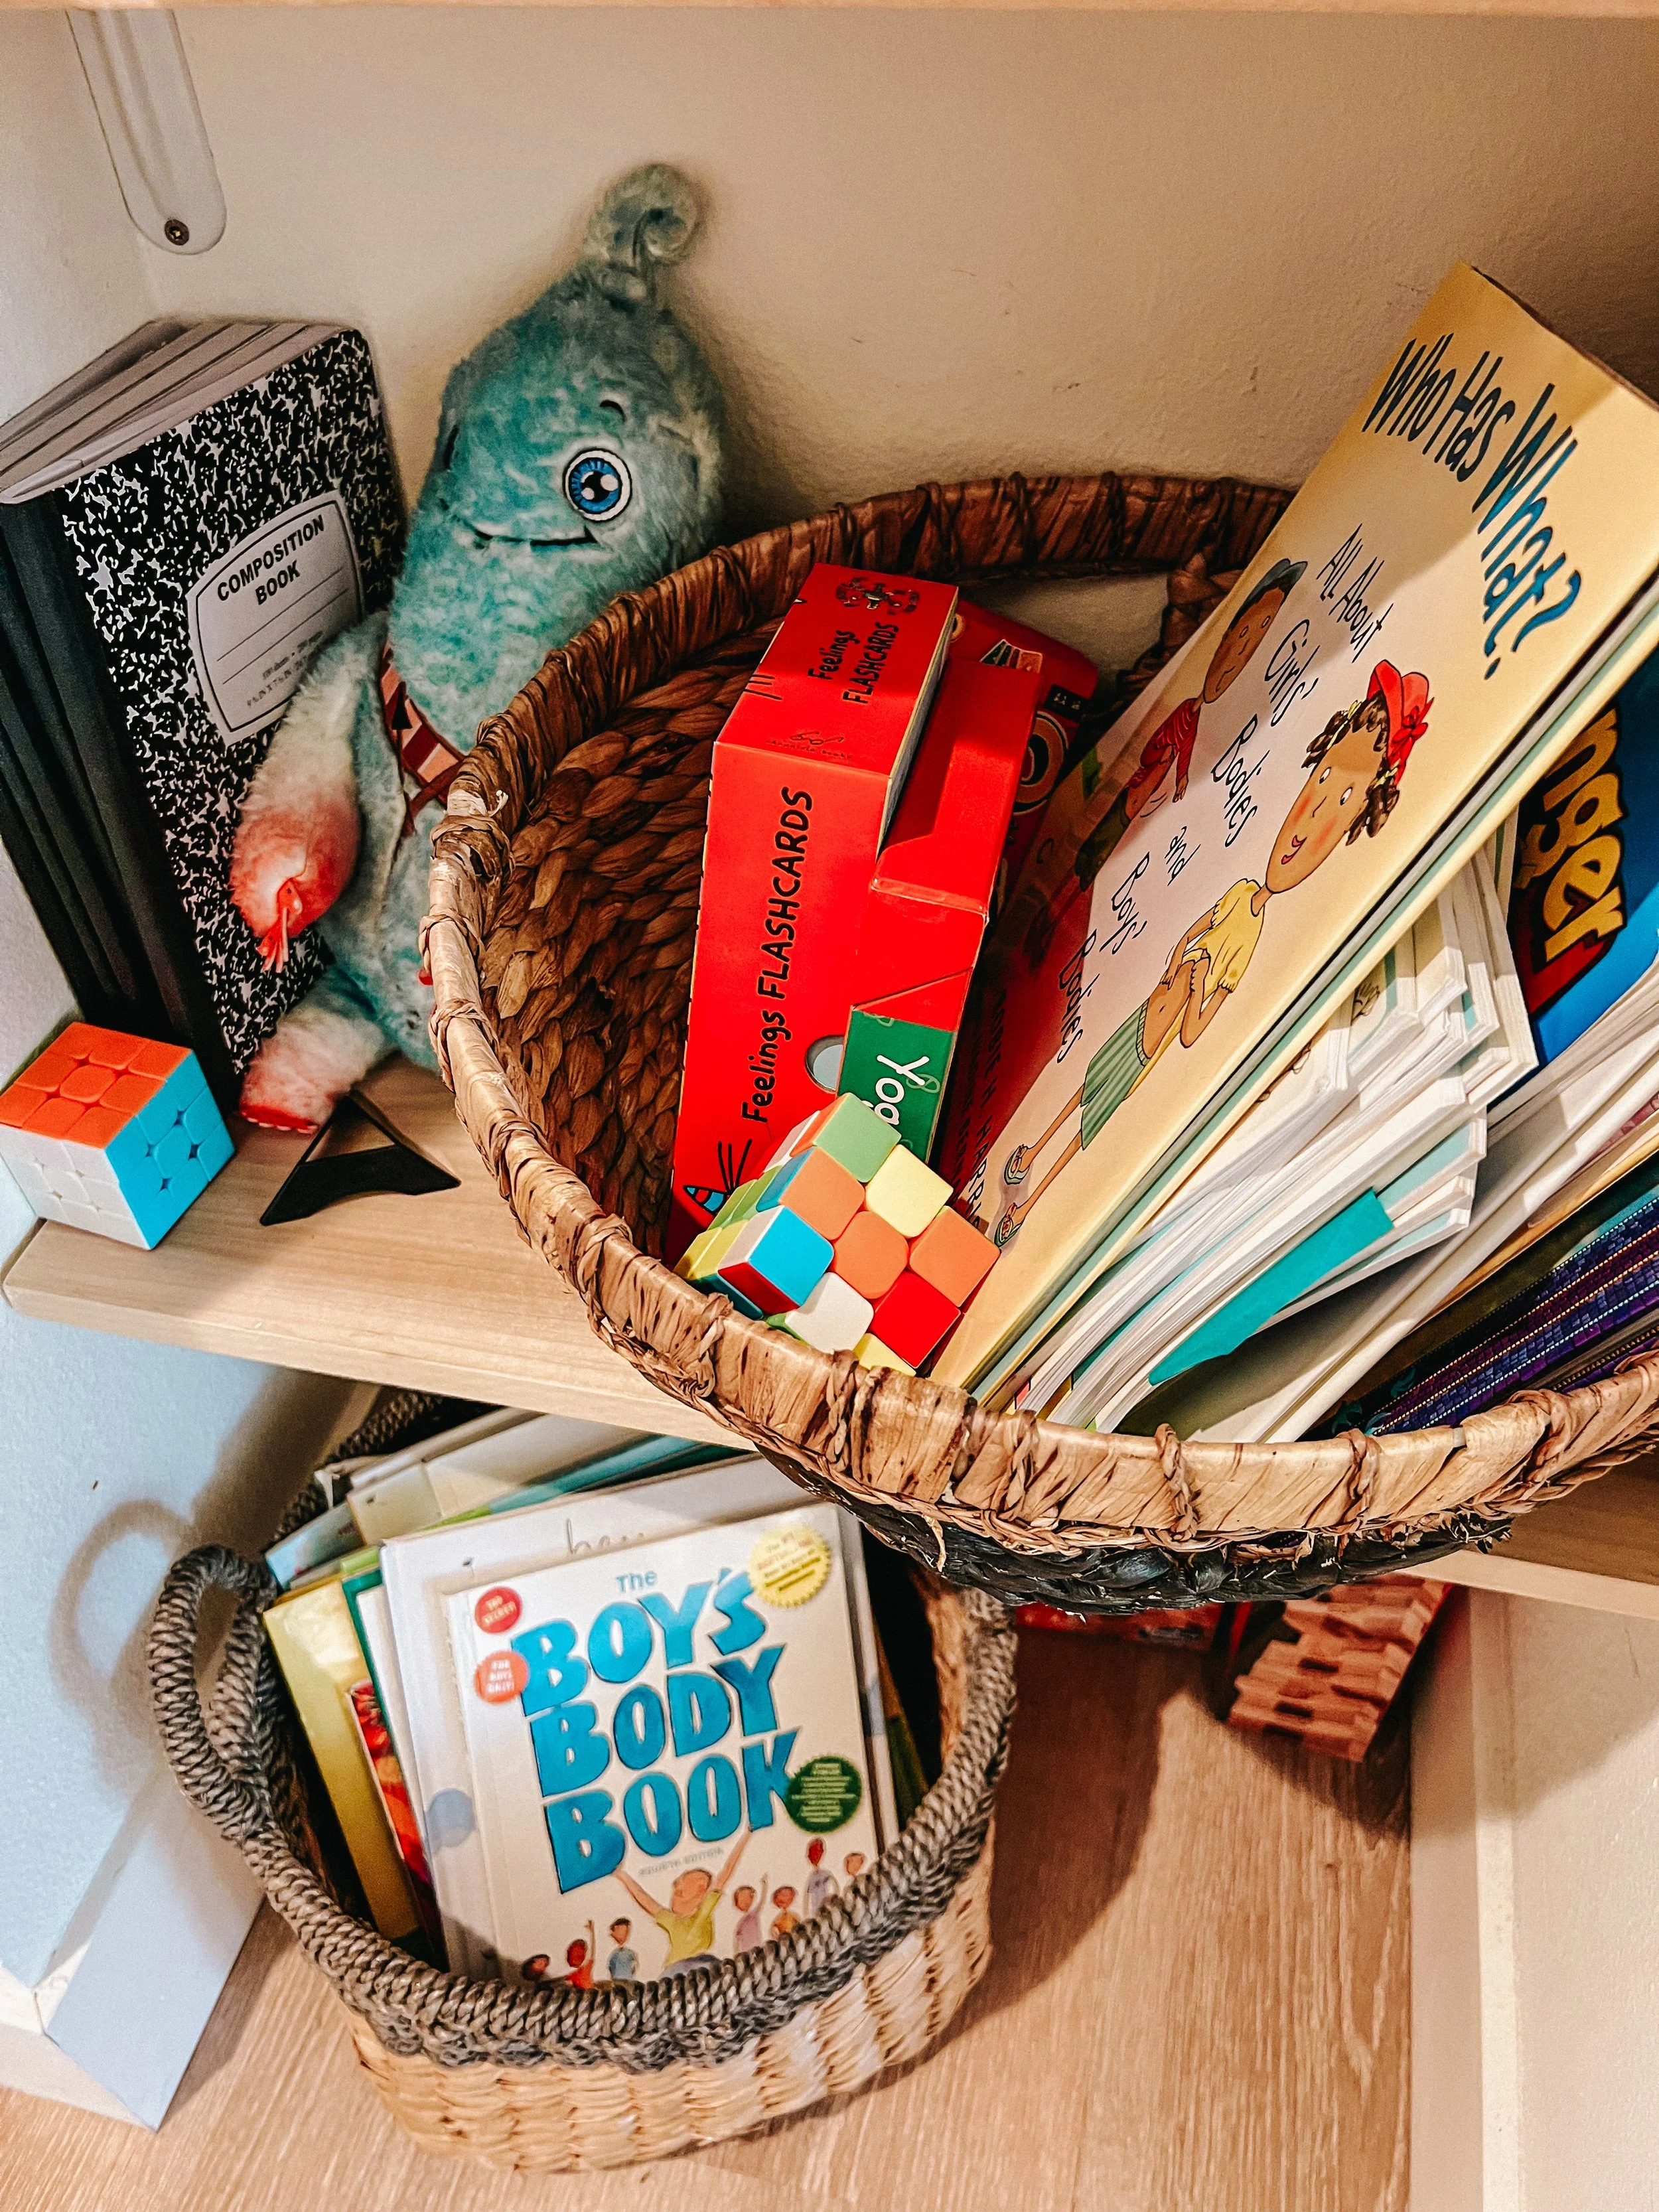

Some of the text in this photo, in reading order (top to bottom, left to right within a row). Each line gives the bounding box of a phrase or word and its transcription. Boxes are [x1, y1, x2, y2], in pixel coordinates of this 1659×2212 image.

[218, 514, 325, 601] COMPOSITION
[1362, 332, 1581, 680] Who Has What?
[255, 560, 301, 605] BOOK
[1316, 523, 1394, 663] All About
[807, 630, 861, 680] Feelings
[843, 622, 899, 703] FLASHCARDS
[1264, 619, 1320, 727] Girls'
[1210, 713, 1270, 848] Bodies
[1514, 708, 1623, 962] nger
[1100, 851, 1150, 955] Boys'
[1165, 826, 1200, 886] and
[741, 786, 813, 1124] Feelings FLASHCARDS
[1056, 929, 1100, 1064] Bodies
[859, 1054, 929, 1126] Yog
[615, 1570, 658, 1592] The
[510, 1568, 766, 1717] BOY'S
[530, 1643, 786, 1797] BODY
[543, 1728, 800, 1895] BOOK
